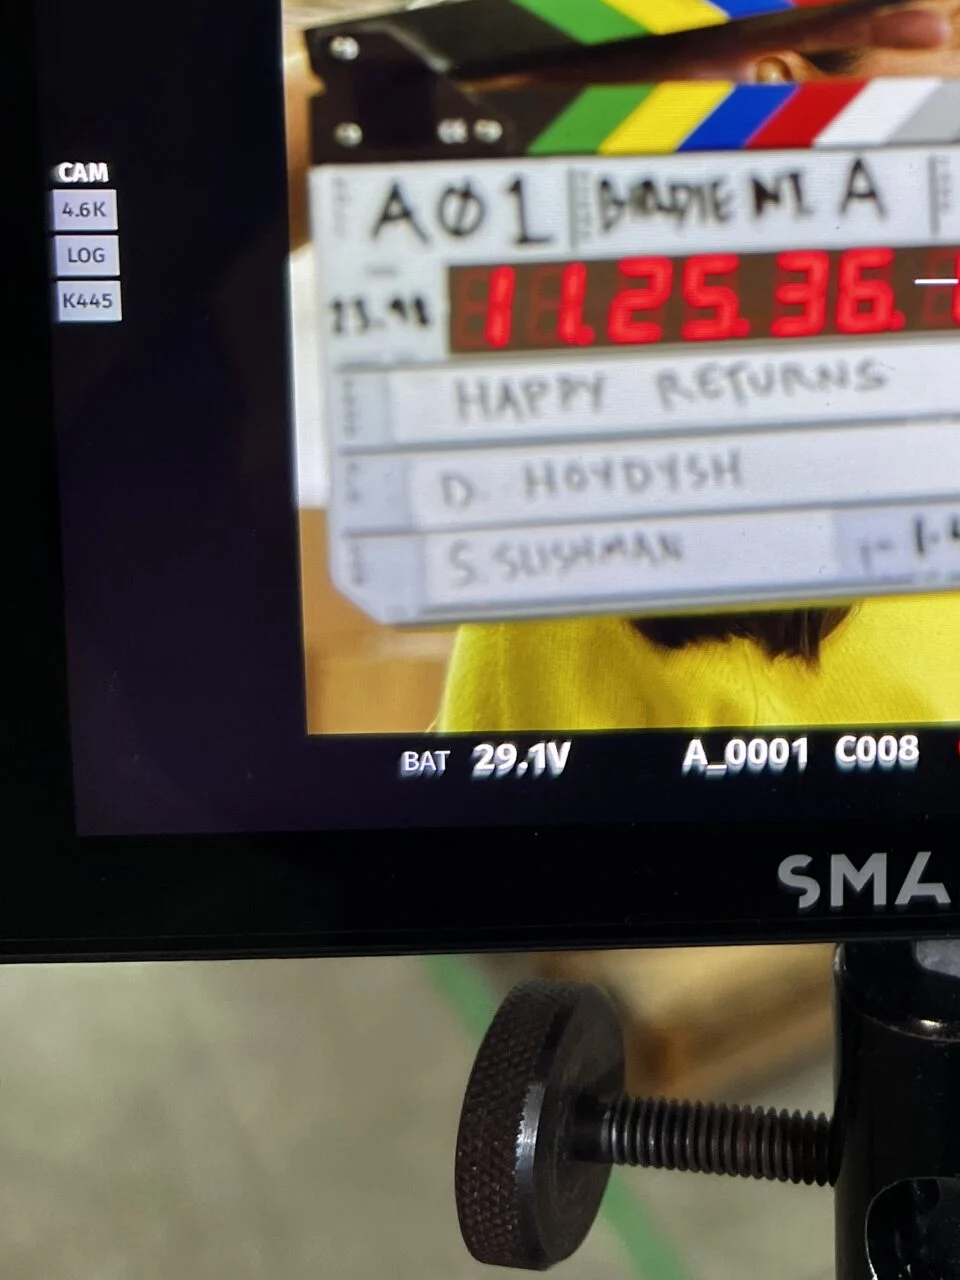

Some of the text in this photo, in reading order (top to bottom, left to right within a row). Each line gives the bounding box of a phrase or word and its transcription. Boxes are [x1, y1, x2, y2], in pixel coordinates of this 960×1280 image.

[56, 162, 109, 183] CAM
[838, 157, 888, 219] A
[62, 201, 107, 217] 4.6K
[68, 247, 105, 263] LOG
[63, 293, 113, 309] K445
[453, 358, 889, 422] HAPPY RETURNS
[402, 741, 571, 774] BAT 29.1V
[683, 733, 919, 771] A_0001 C008
